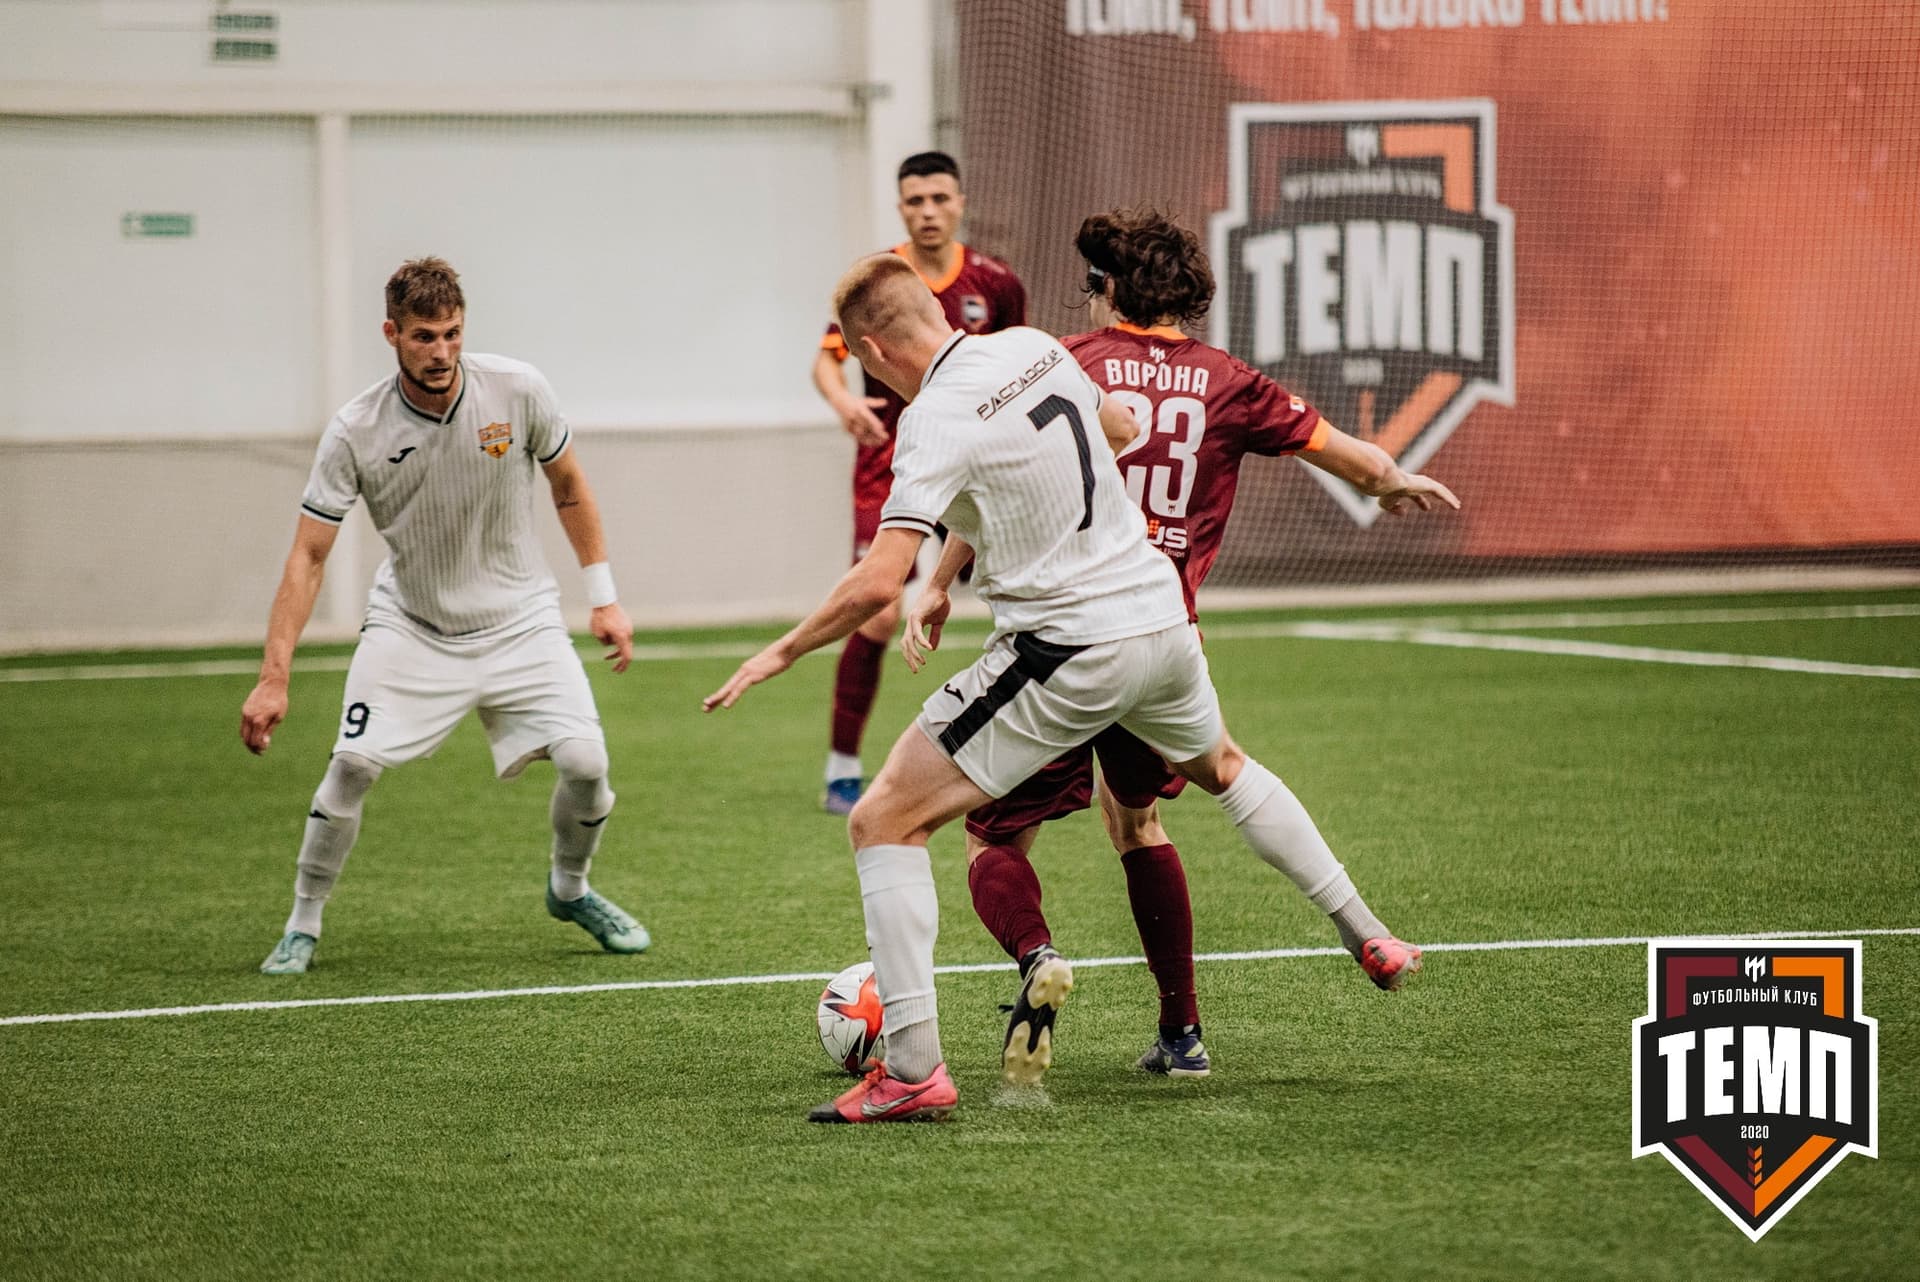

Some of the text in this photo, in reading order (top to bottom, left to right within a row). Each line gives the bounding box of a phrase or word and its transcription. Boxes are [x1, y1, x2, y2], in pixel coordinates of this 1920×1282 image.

[1242, 219, 1484, 366] ТЕМП
[1104, 358, 1210, 397] ВОРОНА
[1026, 394, 1095, 532] 7
[1107, 390, 1206, 518] 23
[344, 702, 370, 739] 9
